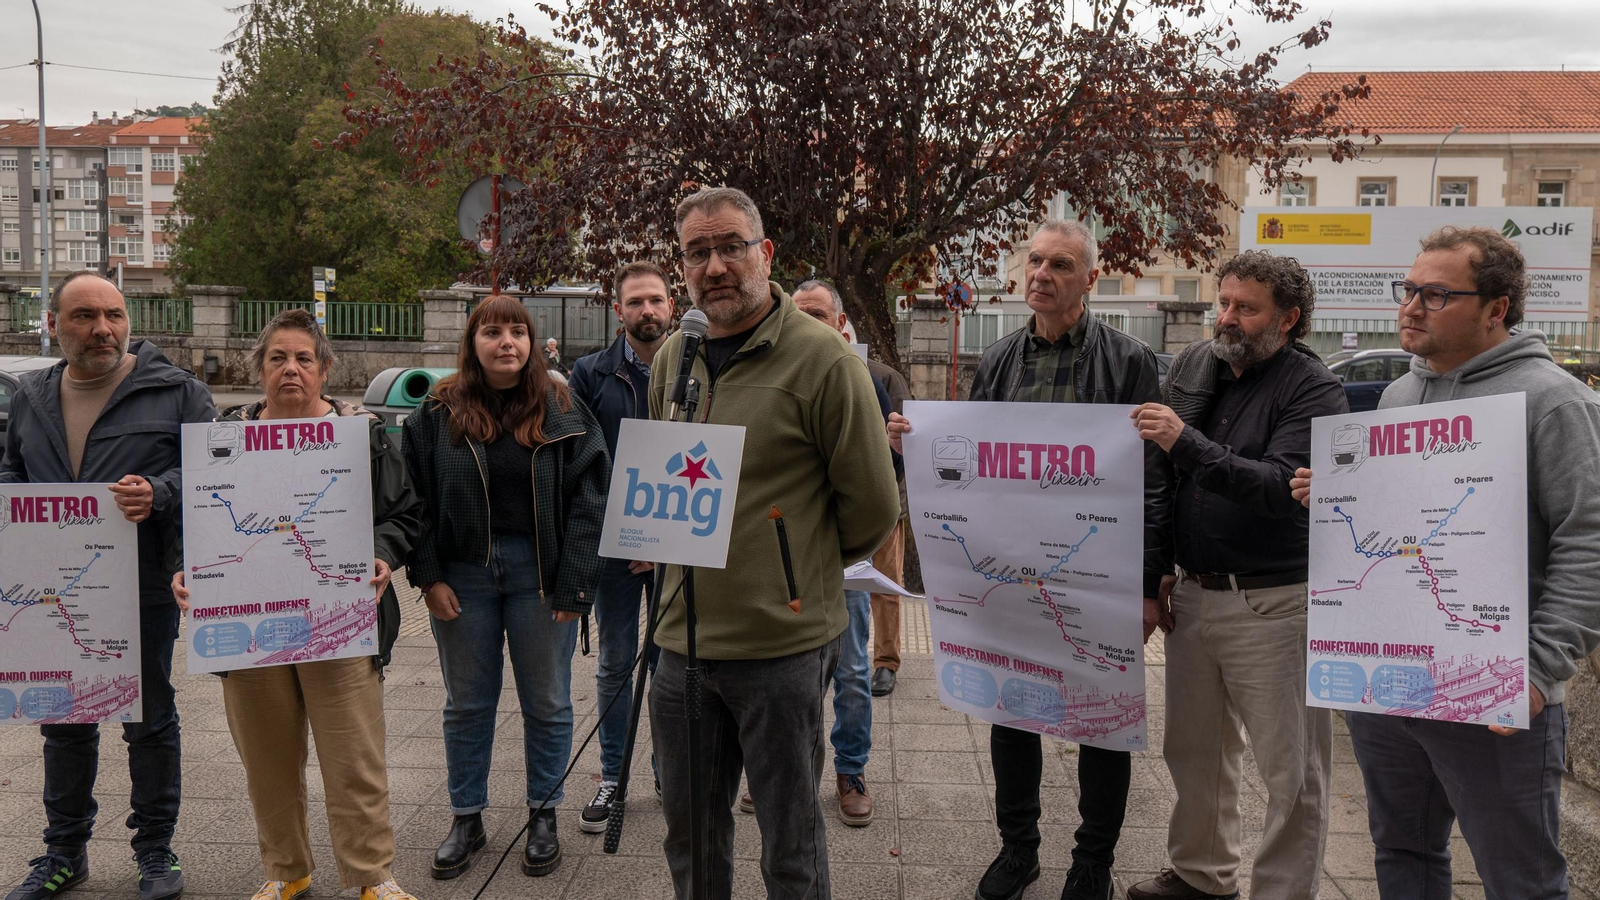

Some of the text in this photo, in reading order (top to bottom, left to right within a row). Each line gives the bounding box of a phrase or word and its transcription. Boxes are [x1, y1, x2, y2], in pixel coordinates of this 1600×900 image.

[1526, 222, 1575, 236] adif
[245, 422, 334, 452] METRO
[1370, 415, 1472, 457] METRO
[293, 436, 342, 456] Lixeiro
[1423, 436, 1482, 461] Lixeiro
[978, 442, 1096, 480] METRO
[1040, 464, 1105, 489] Lixeiro
[623, 467, 722, 537] bng
[11, 496, 98, 523] METRO
[59, 510, 105, 529] Lixeiro
[931, 513, 968, 522] Carballiño
[1075, 513, 1118, 523] Os Peares
[619, 534, 660, 543] NACIONALISTA
[1403, 536, 1416, 544] OU
[1021, 567, 1036, 576] OU
[193, 602, 261, 619] CONECTANDO
[265, 598, 310, 612] OURENSE
[936, 605, 968, 617] Ribadavia
[1473, 604, 1497, 612] Baños
[1480, 613, 1510, 621] Molgas
[1098, 643, 1123, 654] Baños
[1310, 640, 1378, 655] CONECTANDO
[1383, 643, 1434, 658] OURENSE
[940, 640, 1009, 667] CONECTANDO
[1014, 658, 1064, 681] OURENSE
[1106, 652, 1135, 663] Molgas
[30, 671, 72, 681] OURENSE
[1497, 714, 1514, 726] bng
